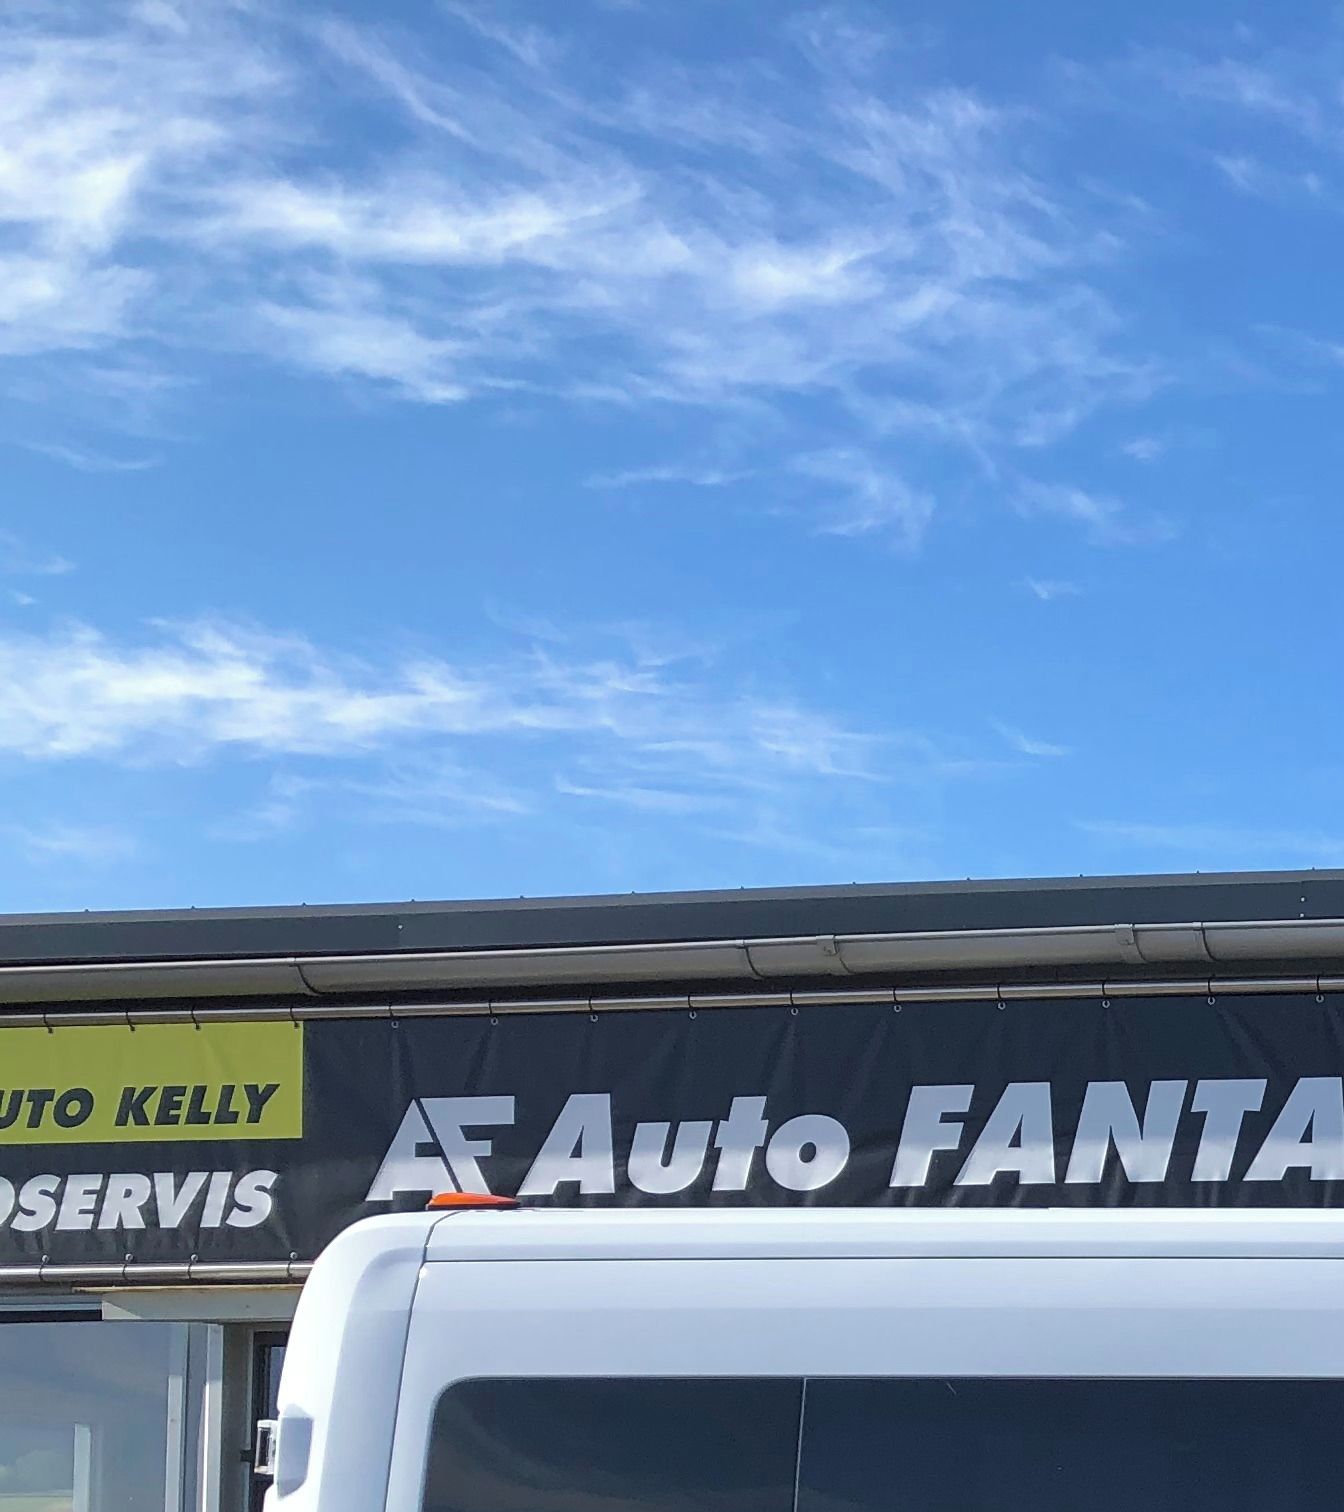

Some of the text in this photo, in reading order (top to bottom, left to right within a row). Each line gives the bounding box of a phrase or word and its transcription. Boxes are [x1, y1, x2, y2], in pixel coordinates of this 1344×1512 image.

[114, 1083, 280, 1127] KELLY
[365, 1095, 515, 1202] AF
[516, 1093, 851, 1196] Auto
